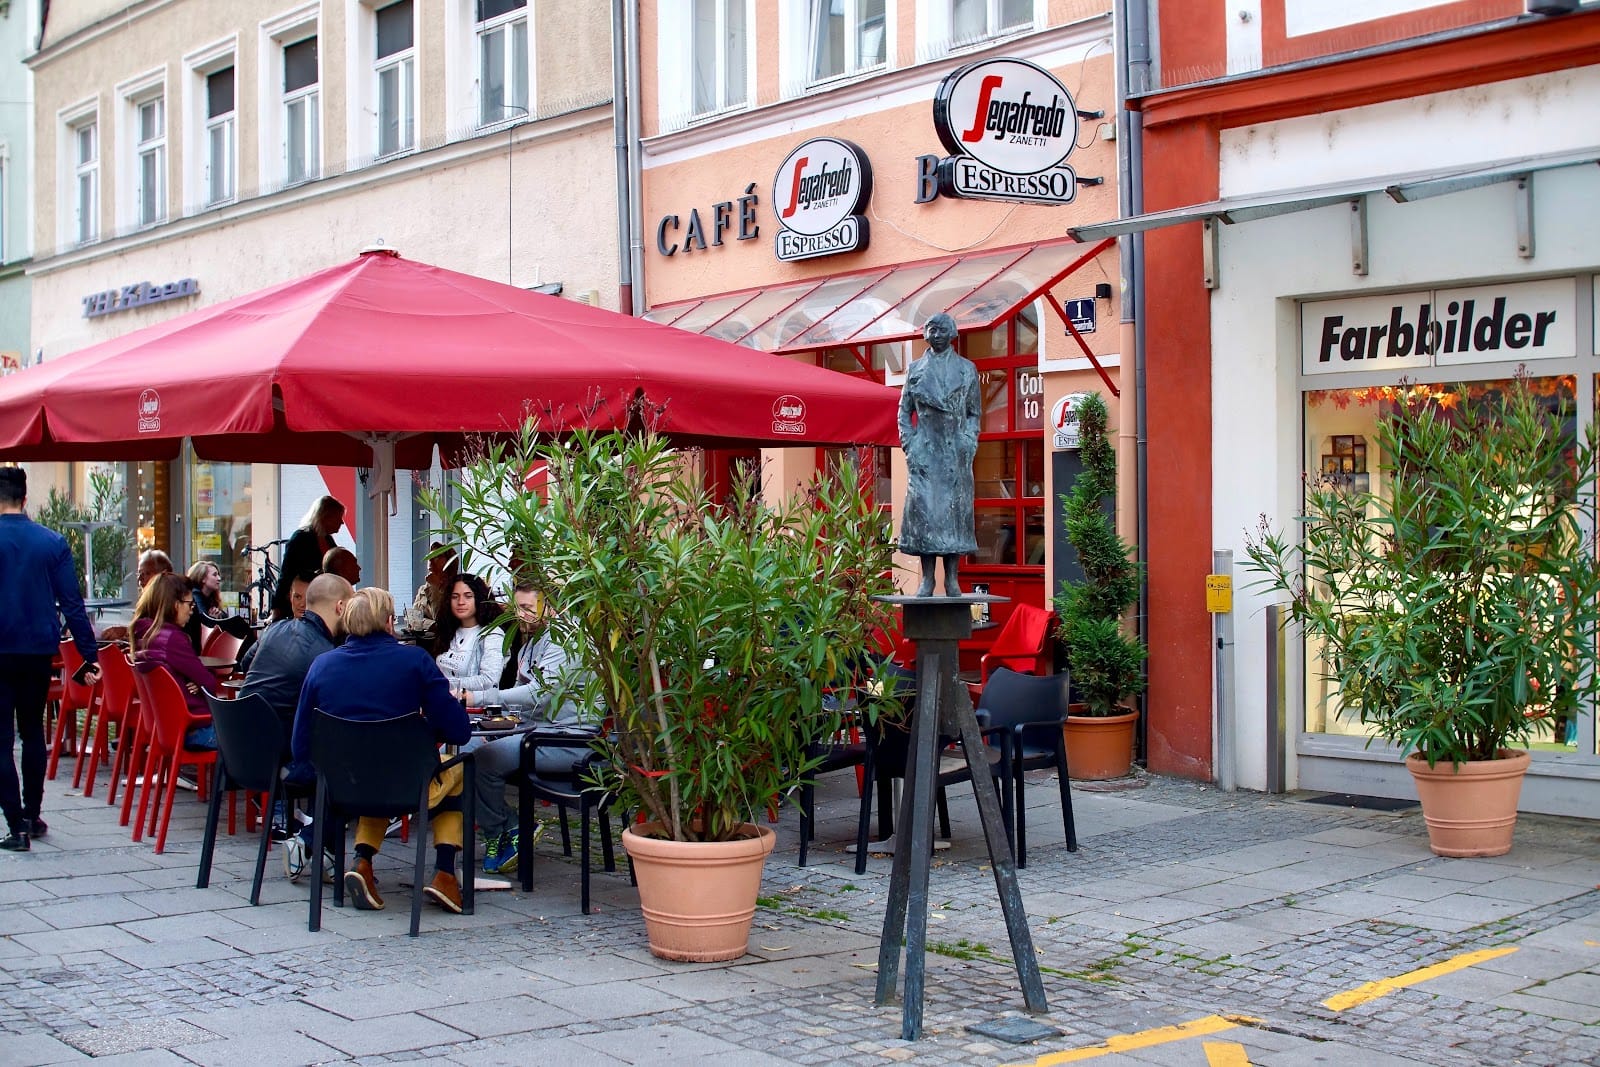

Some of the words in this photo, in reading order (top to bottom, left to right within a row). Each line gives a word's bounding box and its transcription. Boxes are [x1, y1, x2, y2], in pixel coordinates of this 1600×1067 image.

[962, 75, 1065, 143] Segafredo
[1009, 134, 1047, 147] ZANETTI
[782, 156, 852, 219] Segafredo
[961, 164, 1067, 197] ESPRESSO
[657, 183, 759, 256] CAFÉ
[813, 198, 839, 210] ZANETTI
[781, 224, 853, 257] ESPRESSO
[1077, 300, 1082, 319] 1
[1319, 297, 1557, 363] Farbbilder
[1024, 397, 1038, 418] to
